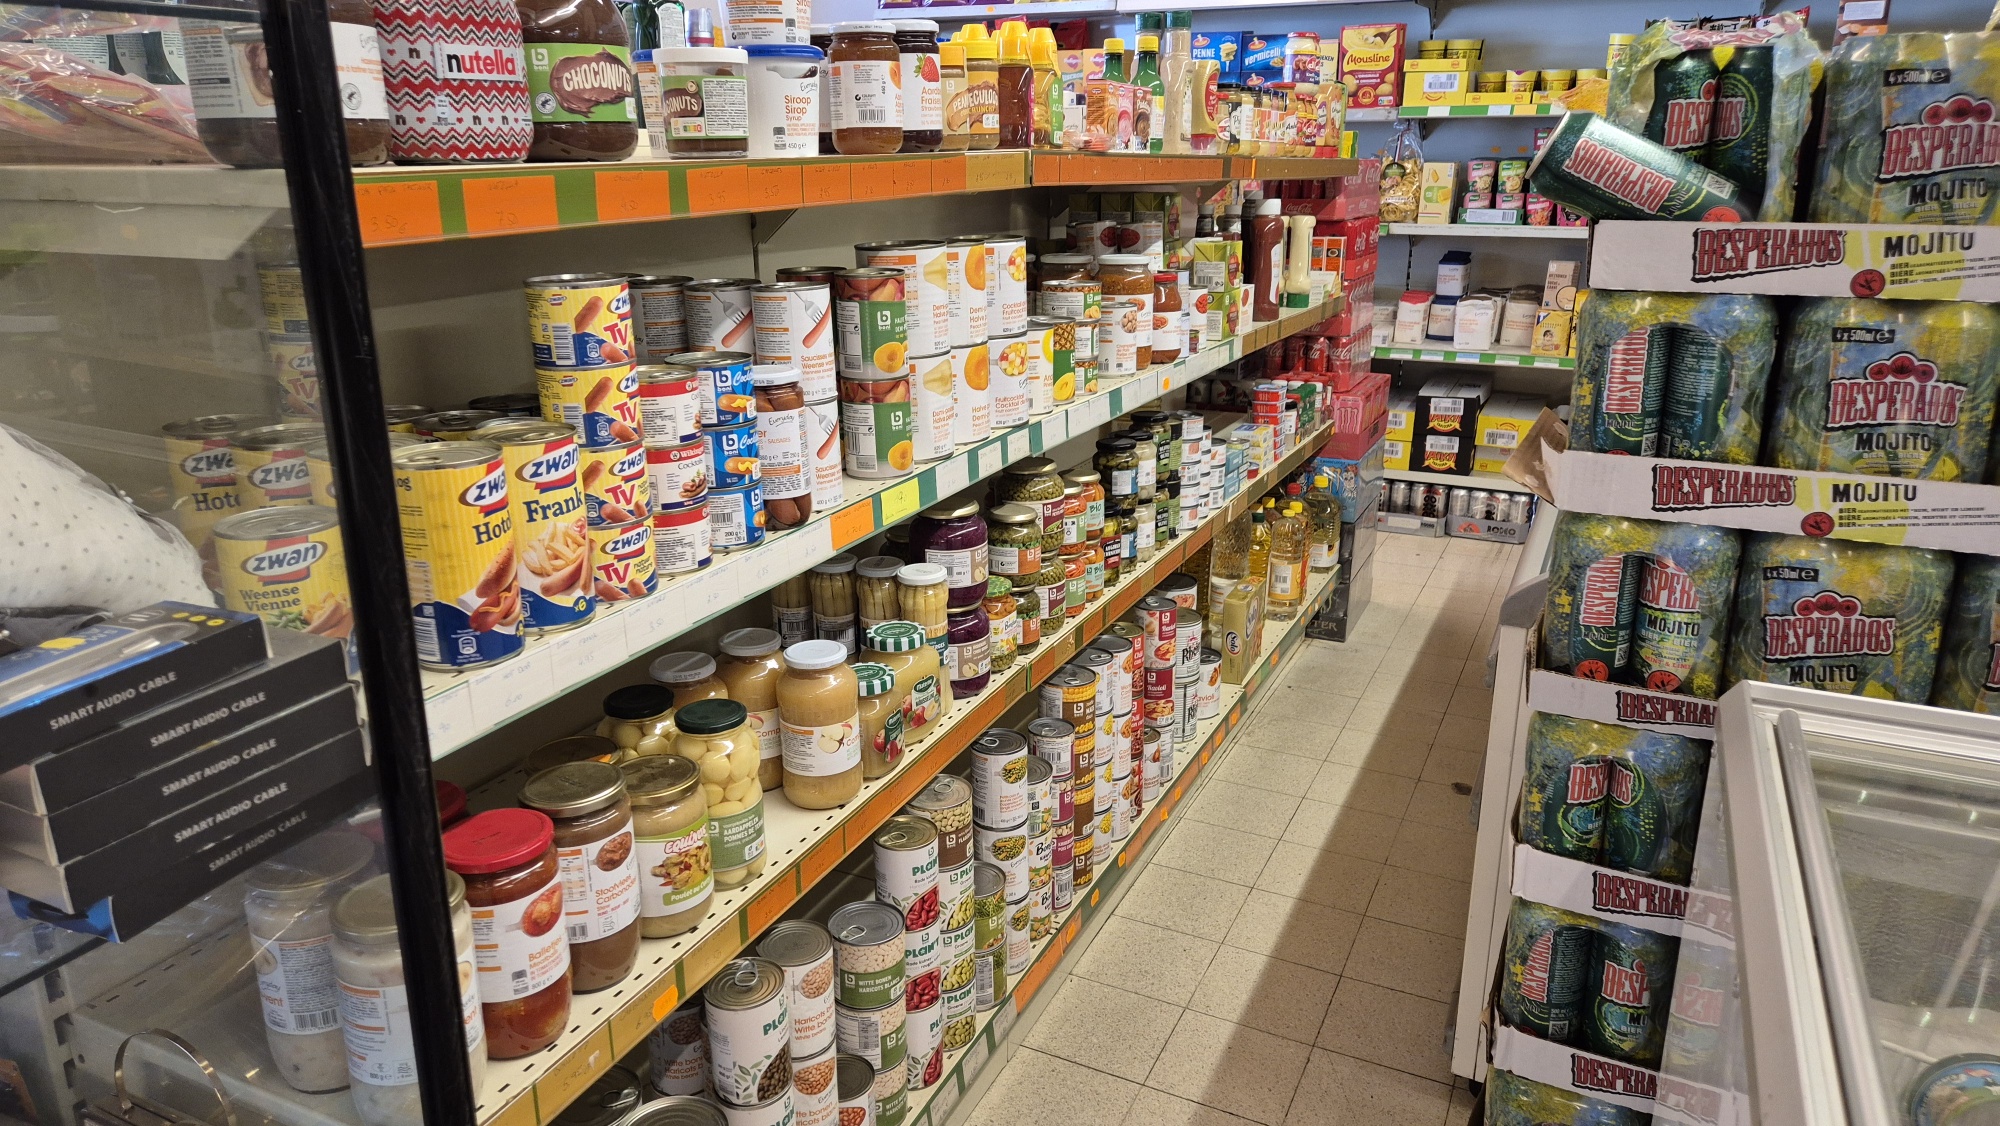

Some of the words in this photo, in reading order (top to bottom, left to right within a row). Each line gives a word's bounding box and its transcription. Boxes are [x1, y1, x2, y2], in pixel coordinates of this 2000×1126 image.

[447, 49, 517, 77] nutella
[1193, 48, 1216, 58] PENNE
[1245, 47, 1281, 66] vermicelli
[1347, 53, 1391, 66] Mousline
[562, 60, 632, 93] CHOCONUTS
[1888, 72, 1897, 84] 4
[784, 95, 812, 106] Siroop
[785, 105, 808, 117] Sirop
[785, 114, 803, 122] Syrup
[1564, 138, 1677, 216] DESPERADOS
[1908, 178, 1987, 206] MOJITO
[1286, 203, 1313, 214] Coca-Cola
[1697, 228, 1845, 276] DESPERADOS
[1883, 231, 1974, 259] MOJITO
[1889, 262, 1909, 270] BIER
[1889, 278, 1909, 286] BIER
[603, 322, 630, 346] TV
[1850, 330, 1874, 342] 500ml
[613, 401, 638, 424] TV
[1830, 381, 1966, 425] DESPERADOS
[1855, 433, 1932, 455] MOJITO
[604, 484, 636, 507] TV
[1657, 465, 1795, 507] DESPERADOS
[1832, 482, 1918, 503] MOJITO
[610, 527, 648, 553] zwan
[252, 545, 318, 573] zwan
[596, 563, 631, 586] TV
[238, 585, 300, 602] Weense
[244, 596, 301, 612] Vienne
[1647, 614, 1701, 638] MOJITO
[1766, 617, 1894, 657] DESPERADOS
[1789, 664, 1858, 684] MOJITO
[50, 704, 94, 730] SMART
[96, 688, 136, 712] AUDIO
[139, 671, 177, 694] CABLE
[150, 724, 192, 748] SMART
[192, 707, 230, 730] AUDIO
[231, 691, 266, 712] CABLE
[162, 771, 202, 796] SMART
[203, 755, 240, 778] AUDIO
[242, 738, 277, 760] CABLE
[174, 818, 215, 843] SMART
[216, 800, 252, 824] AUDIO
[253, 782, 288, 805] CABLE
[724, 833, 748, 843] POMMES
[748, 830, 755, 838] DE
[671, 888, 692, 902] Poulet
[794, 1011, 826, 1026] Haricots
[795, 1024, 816, 1035] Witte
[1620, 1026, 1643, 1035] BIER
[664, 1064, 696, 1074] Haricots
[665, 1058, 682, 1068] Witte
